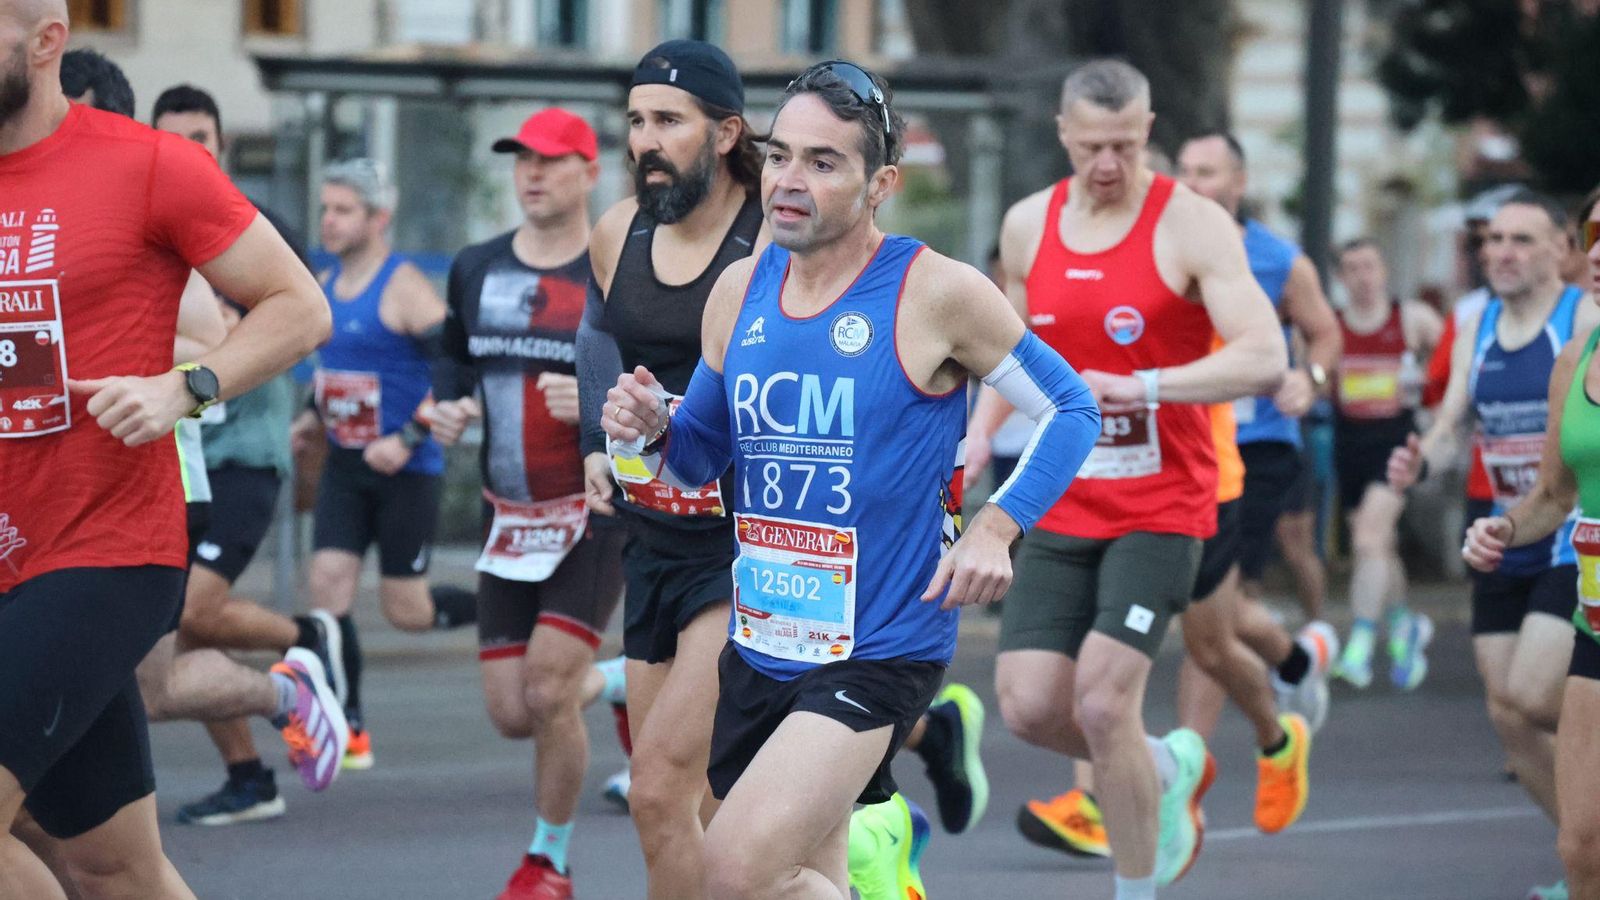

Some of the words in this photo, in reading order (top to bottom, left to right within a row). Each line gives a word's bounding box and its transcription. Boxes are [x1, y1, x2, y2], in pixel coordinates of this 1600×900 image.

[733, 371, 855, 437] RCM
[754, 442, 778, 453] CLUB
[778, 443, 853, 457] MEDITERRANEO
[743, 461, 852, 515] 1873
[750, 567, 821, 601] 12502
[808, 631, 830, 642] 21K
